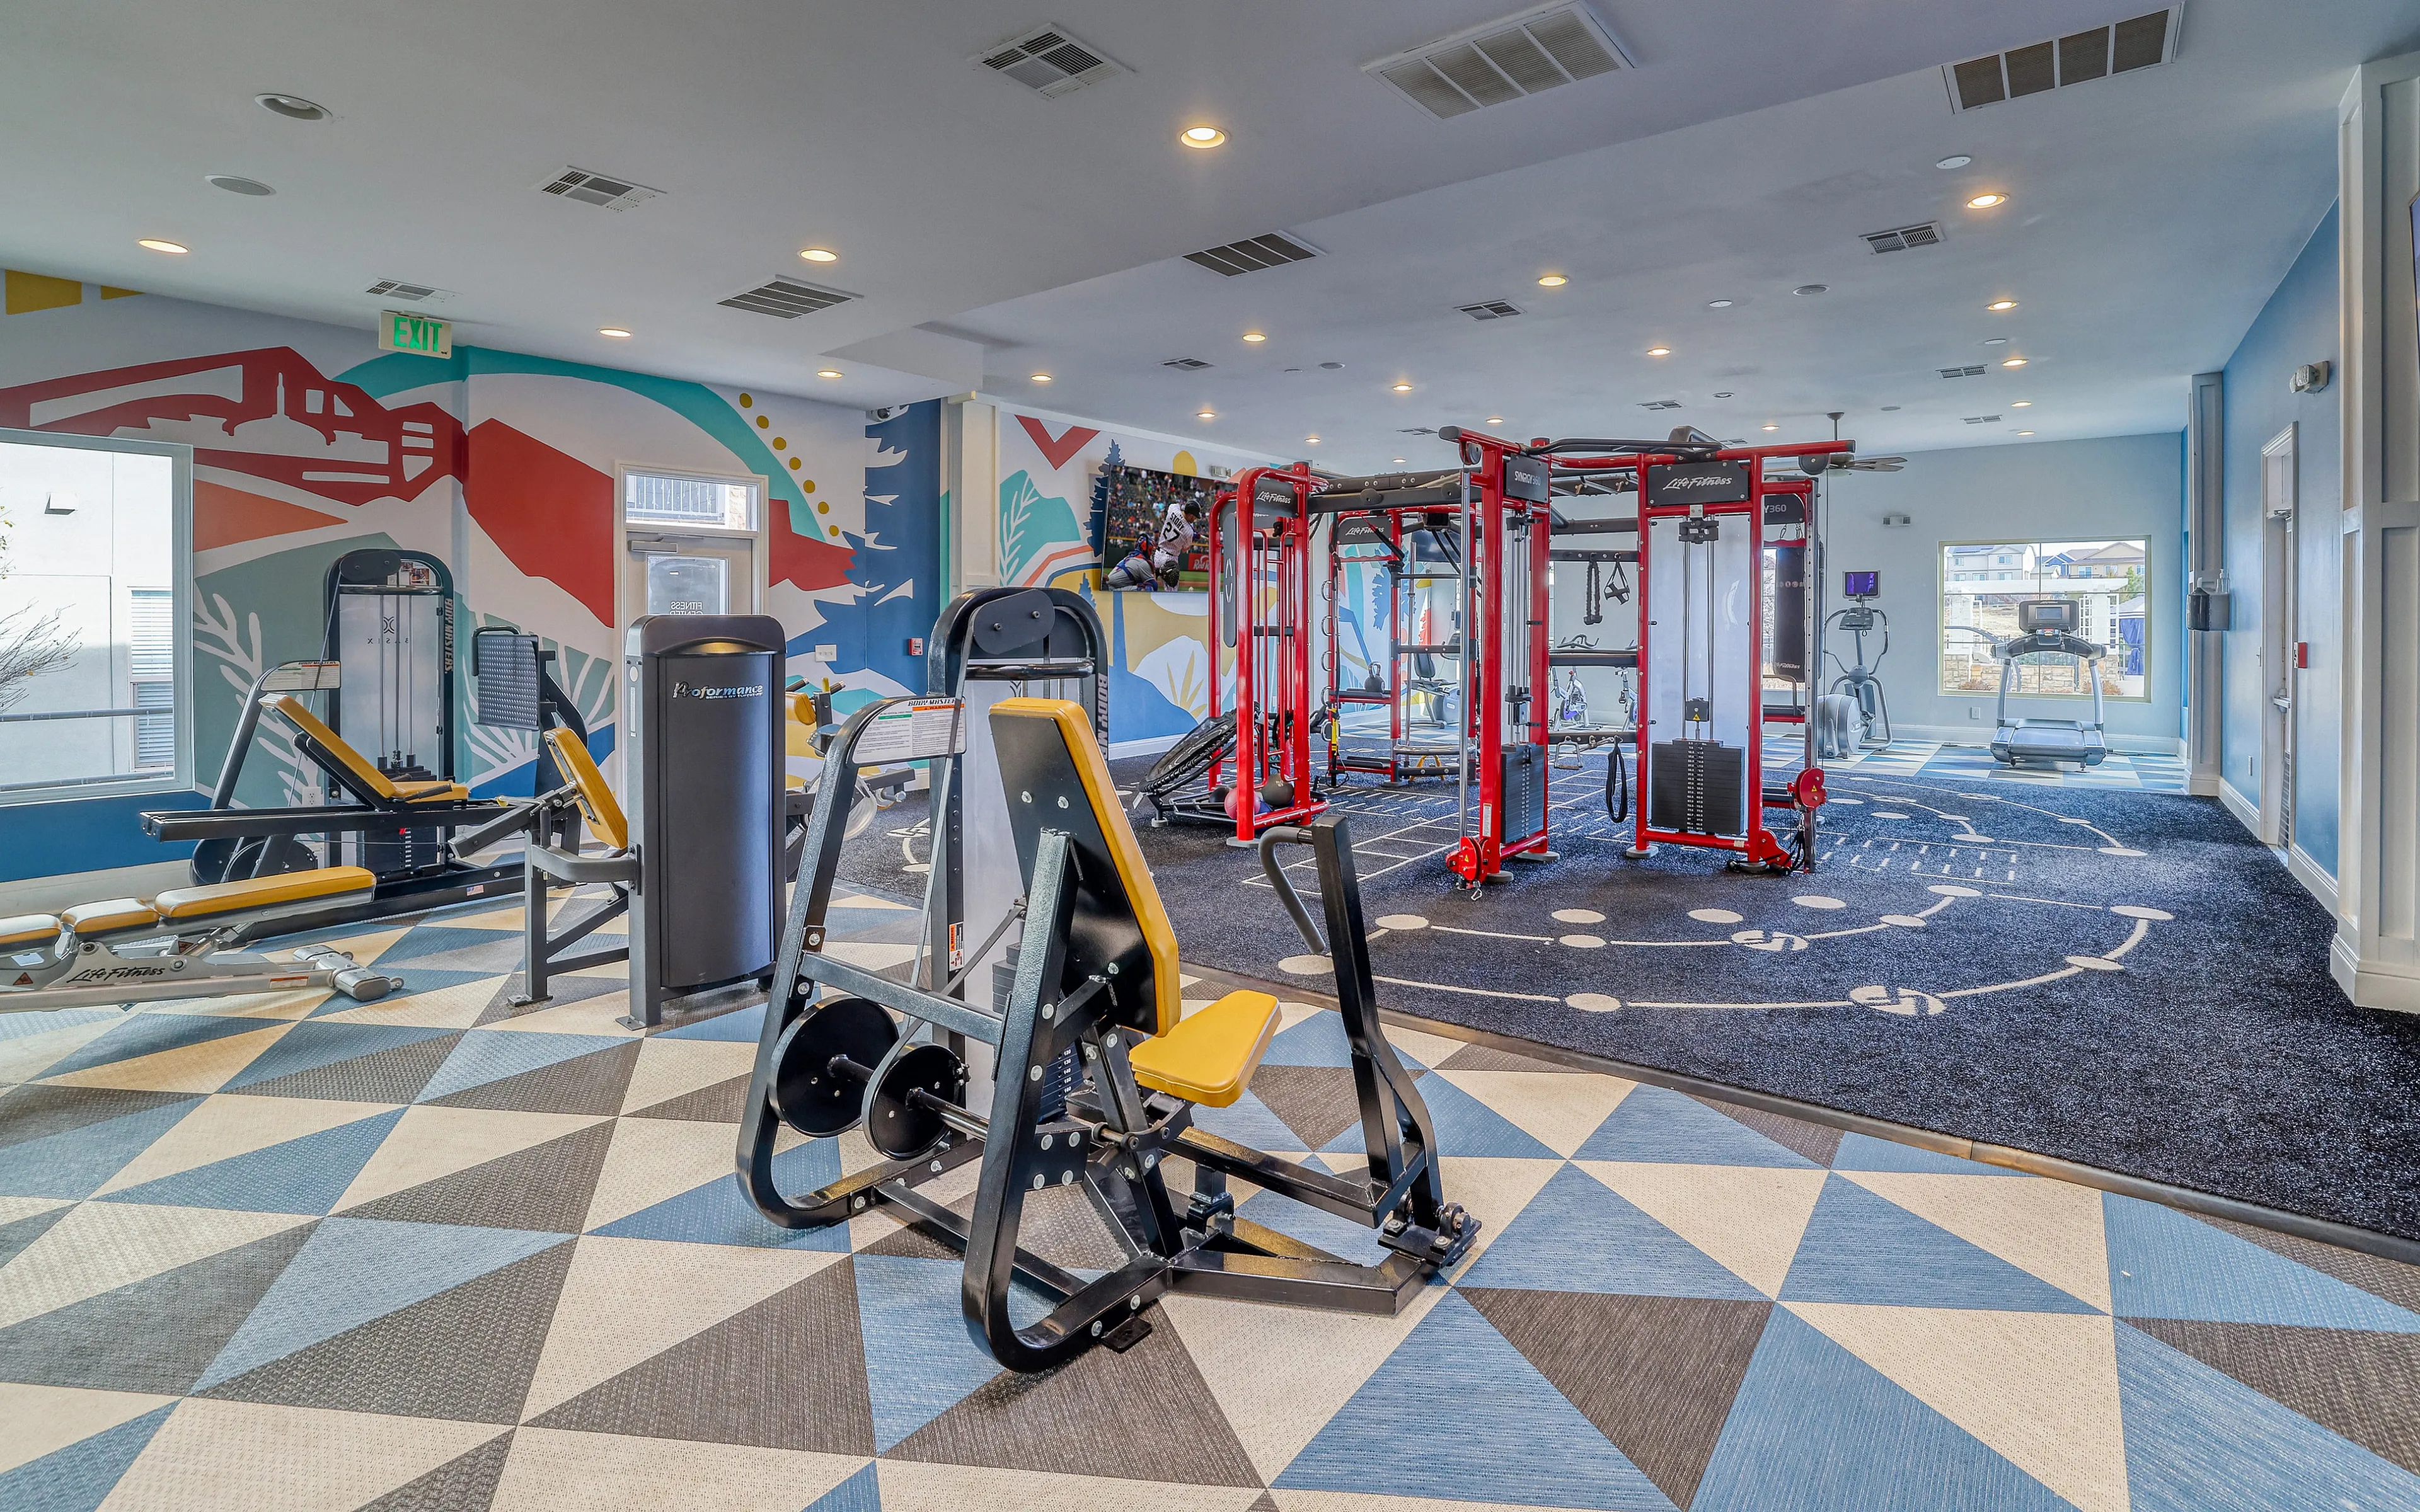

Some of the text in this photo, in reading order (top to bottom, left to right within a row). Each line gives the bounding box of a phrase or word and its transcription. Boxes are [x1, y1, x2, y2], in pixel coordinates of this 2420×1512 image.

[393, 316, 442, 352] EXIT
[1514, 471, 1541, 486] SYNRGY360
[1662, 477, 1732, 490] Life Fitness
[1256, 491, 1291, 504] Life Fitness
[1764, 504, 1787, 513] Y360
[1170, 512, 1185, 531] STORY
[1163, 522, 1180, 542] 27
[672, 682, 763, 699] Proformance
[1098, 673, 1107, 728] BODY
[66, 966, 166, 983] Life Fitness
